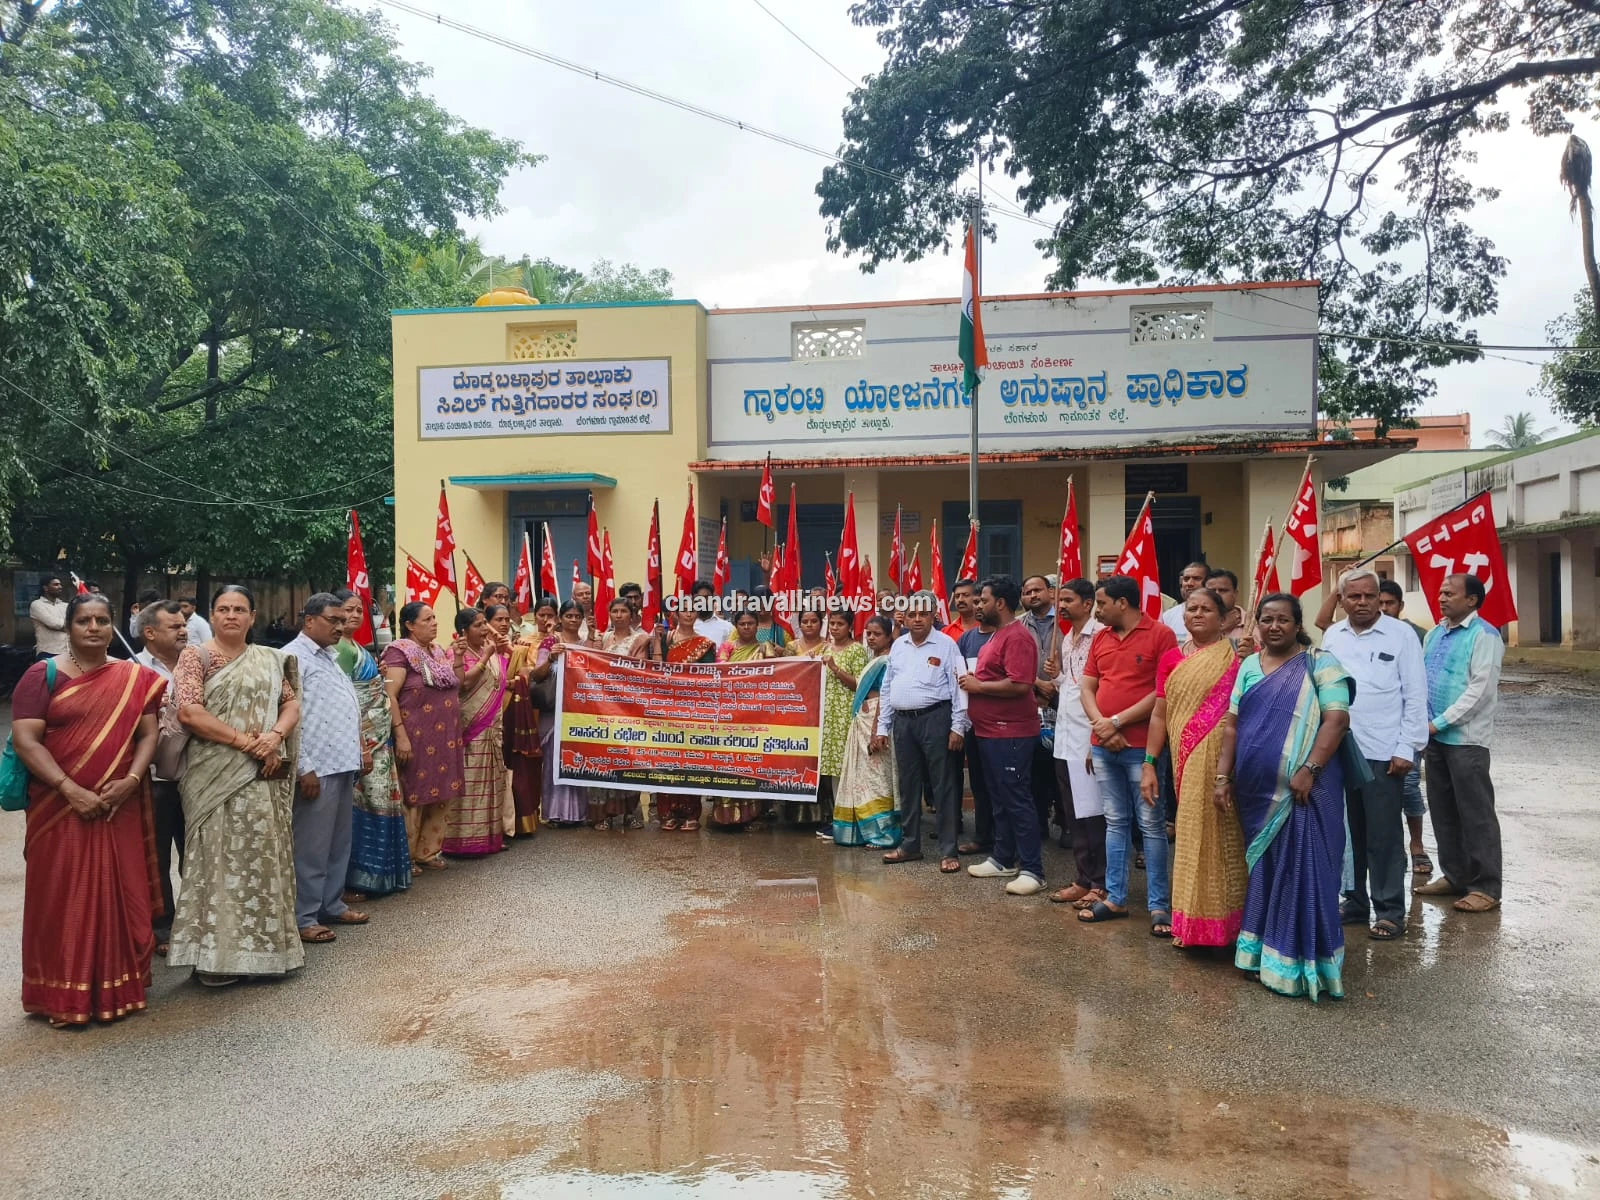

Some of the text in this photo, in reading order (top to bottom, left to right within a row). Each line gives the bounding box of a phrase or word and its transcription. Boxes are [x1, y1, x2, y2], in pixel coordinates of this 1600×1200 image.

[985, 359, 1024, 370] ಂಚಾಯಿತಿ
[1030, 357, 1074, 369] ಸಂಕೀರ್ಣ
[437, 393, 486, 413] ಸಿವಿಲ್
[491, 391, 587, 415] ಗುತ್ತಿಗೆದಾರರ
[743, 383, 824, 421] ಗ್ಯಾರಂಟಿ
[1126, 363, 1248, 406] ಪ್ರಾಧಿಕಾರ
[1004, 411, 1047, 423] ಬೆಂಗಳೂರು
[1059, 409, 1101, 424] ಗ್ರಾಮಾಂತರ
[1288, 474, 1313, 531] ITU
[1416, 504, 1485, 554] CITU
[609, 657, 646, 670] ಮಾತು
[689, 664, 722, 679] ರಾಜ್ಯ
[727, 664, 775, 676] ಸರ್ಕಾರ
[569, 725, 609, 739] ಶಾಸಕರ
[652, 730, 685, 743] ಮುಂದೆ
[689, 735, 759, 748] ಕಾರ್ಮಿಕರಿಂದ
[763, 737, 809, 753] ಪ್ರತಿಭಟನೆ
